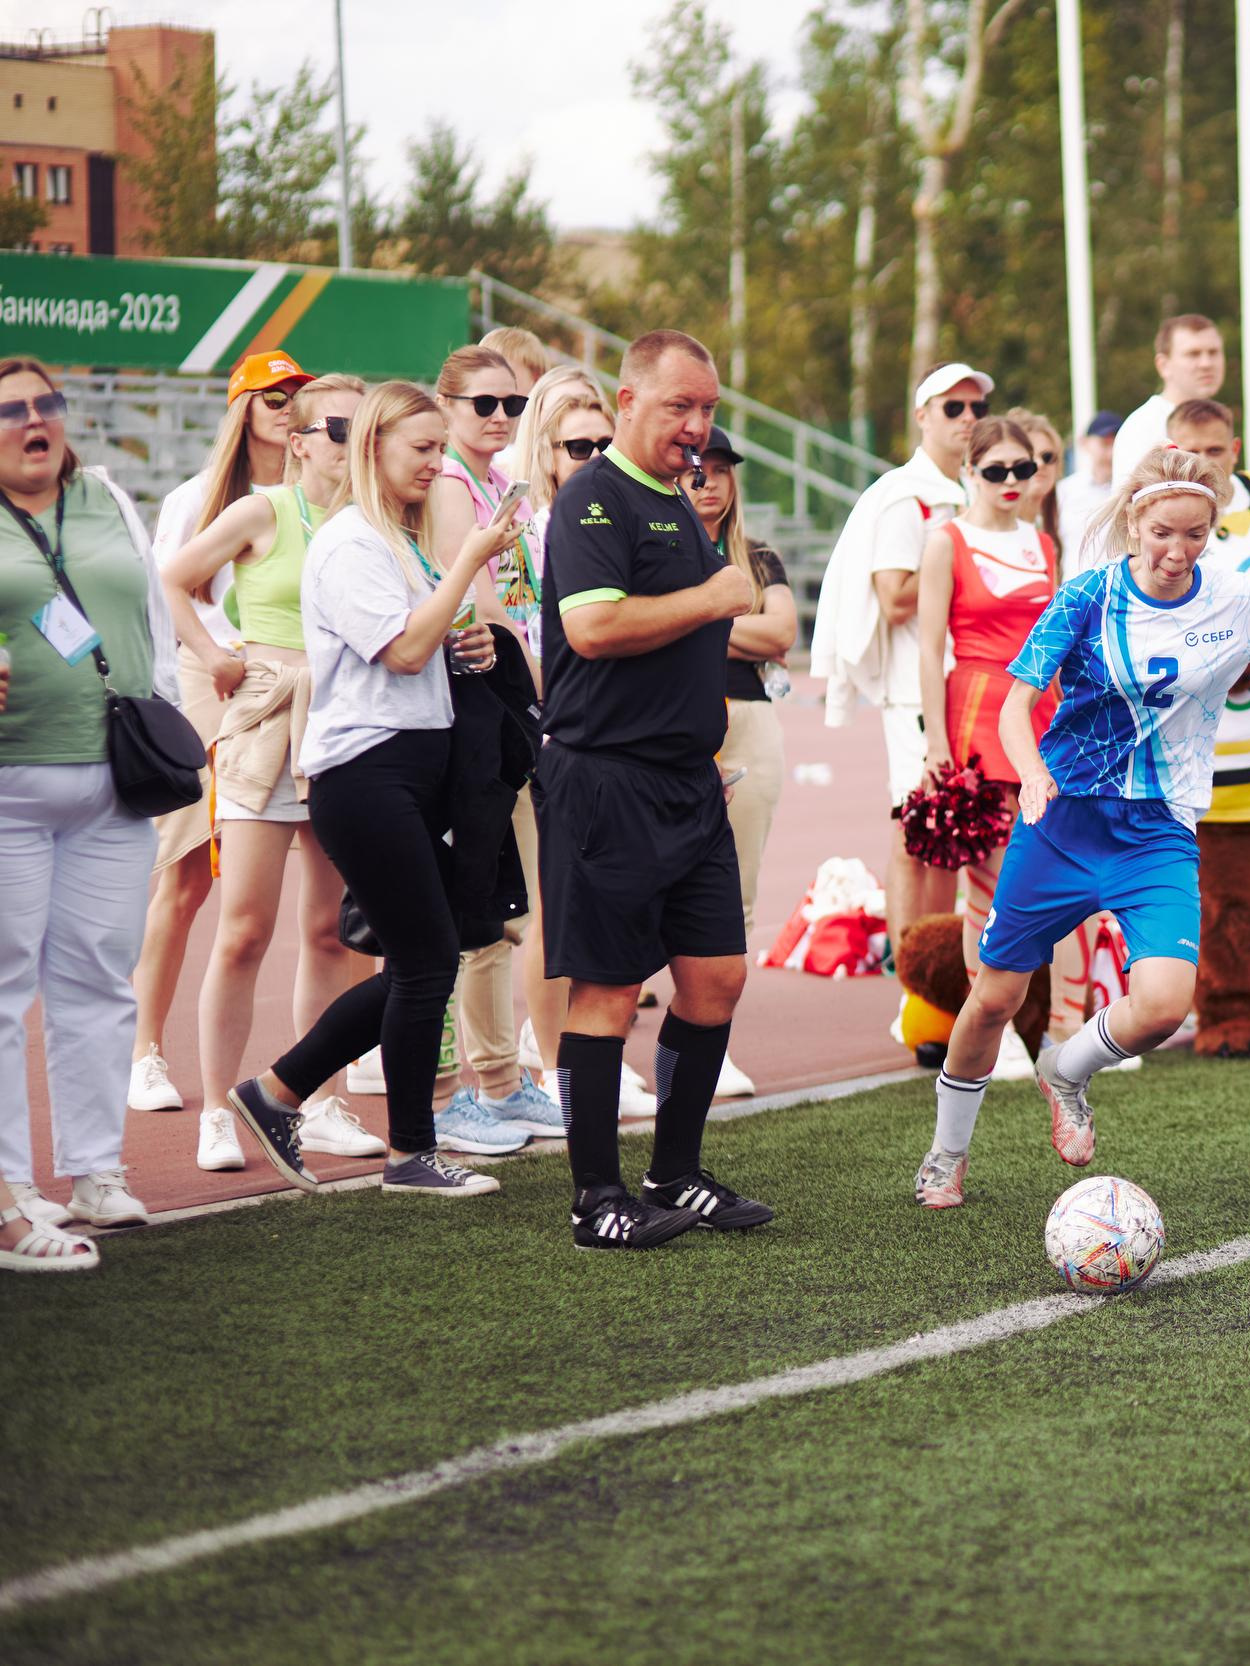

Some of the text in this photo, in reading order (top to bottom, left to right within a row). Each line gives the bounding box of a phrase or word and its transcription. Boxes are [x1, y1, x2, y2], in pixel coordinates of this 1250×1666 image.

[0, 290, 181, 335] анкиада-2023
[648, 521, 680, 532] KELME
[1201, 629, 1234, 643] СБЕР
[1142, 656, 1179, 709] 2
